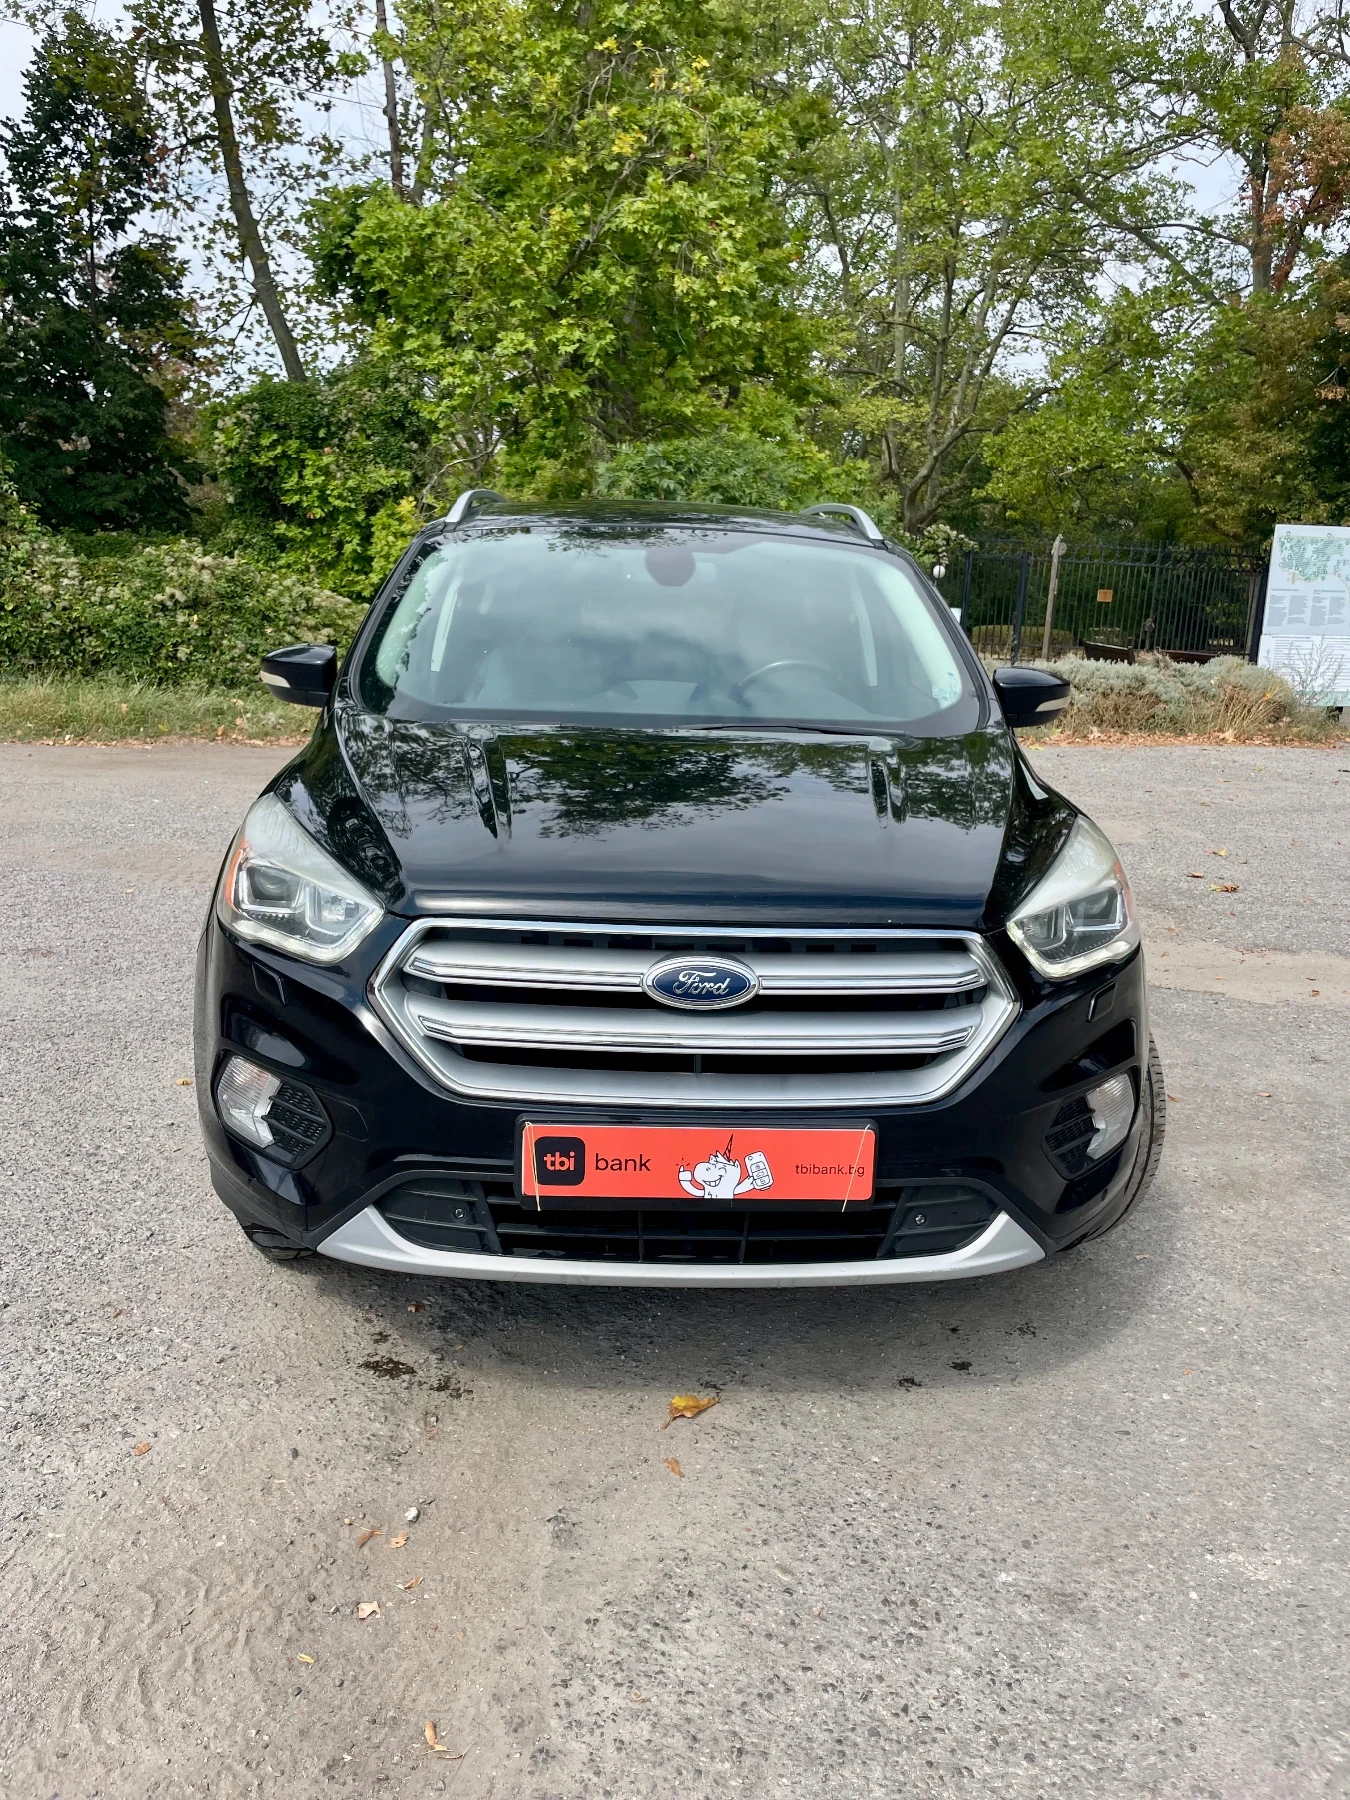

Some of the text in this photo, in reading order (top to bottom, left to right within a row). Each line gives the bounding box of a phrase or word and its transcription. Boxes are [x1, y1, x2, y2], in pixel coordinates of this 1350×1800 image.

[672, 970, 731, 995] Ford
[543, 1151, 652, 1172] tbi bank
[795, 1164, 865, 1178] tbibank.bg
